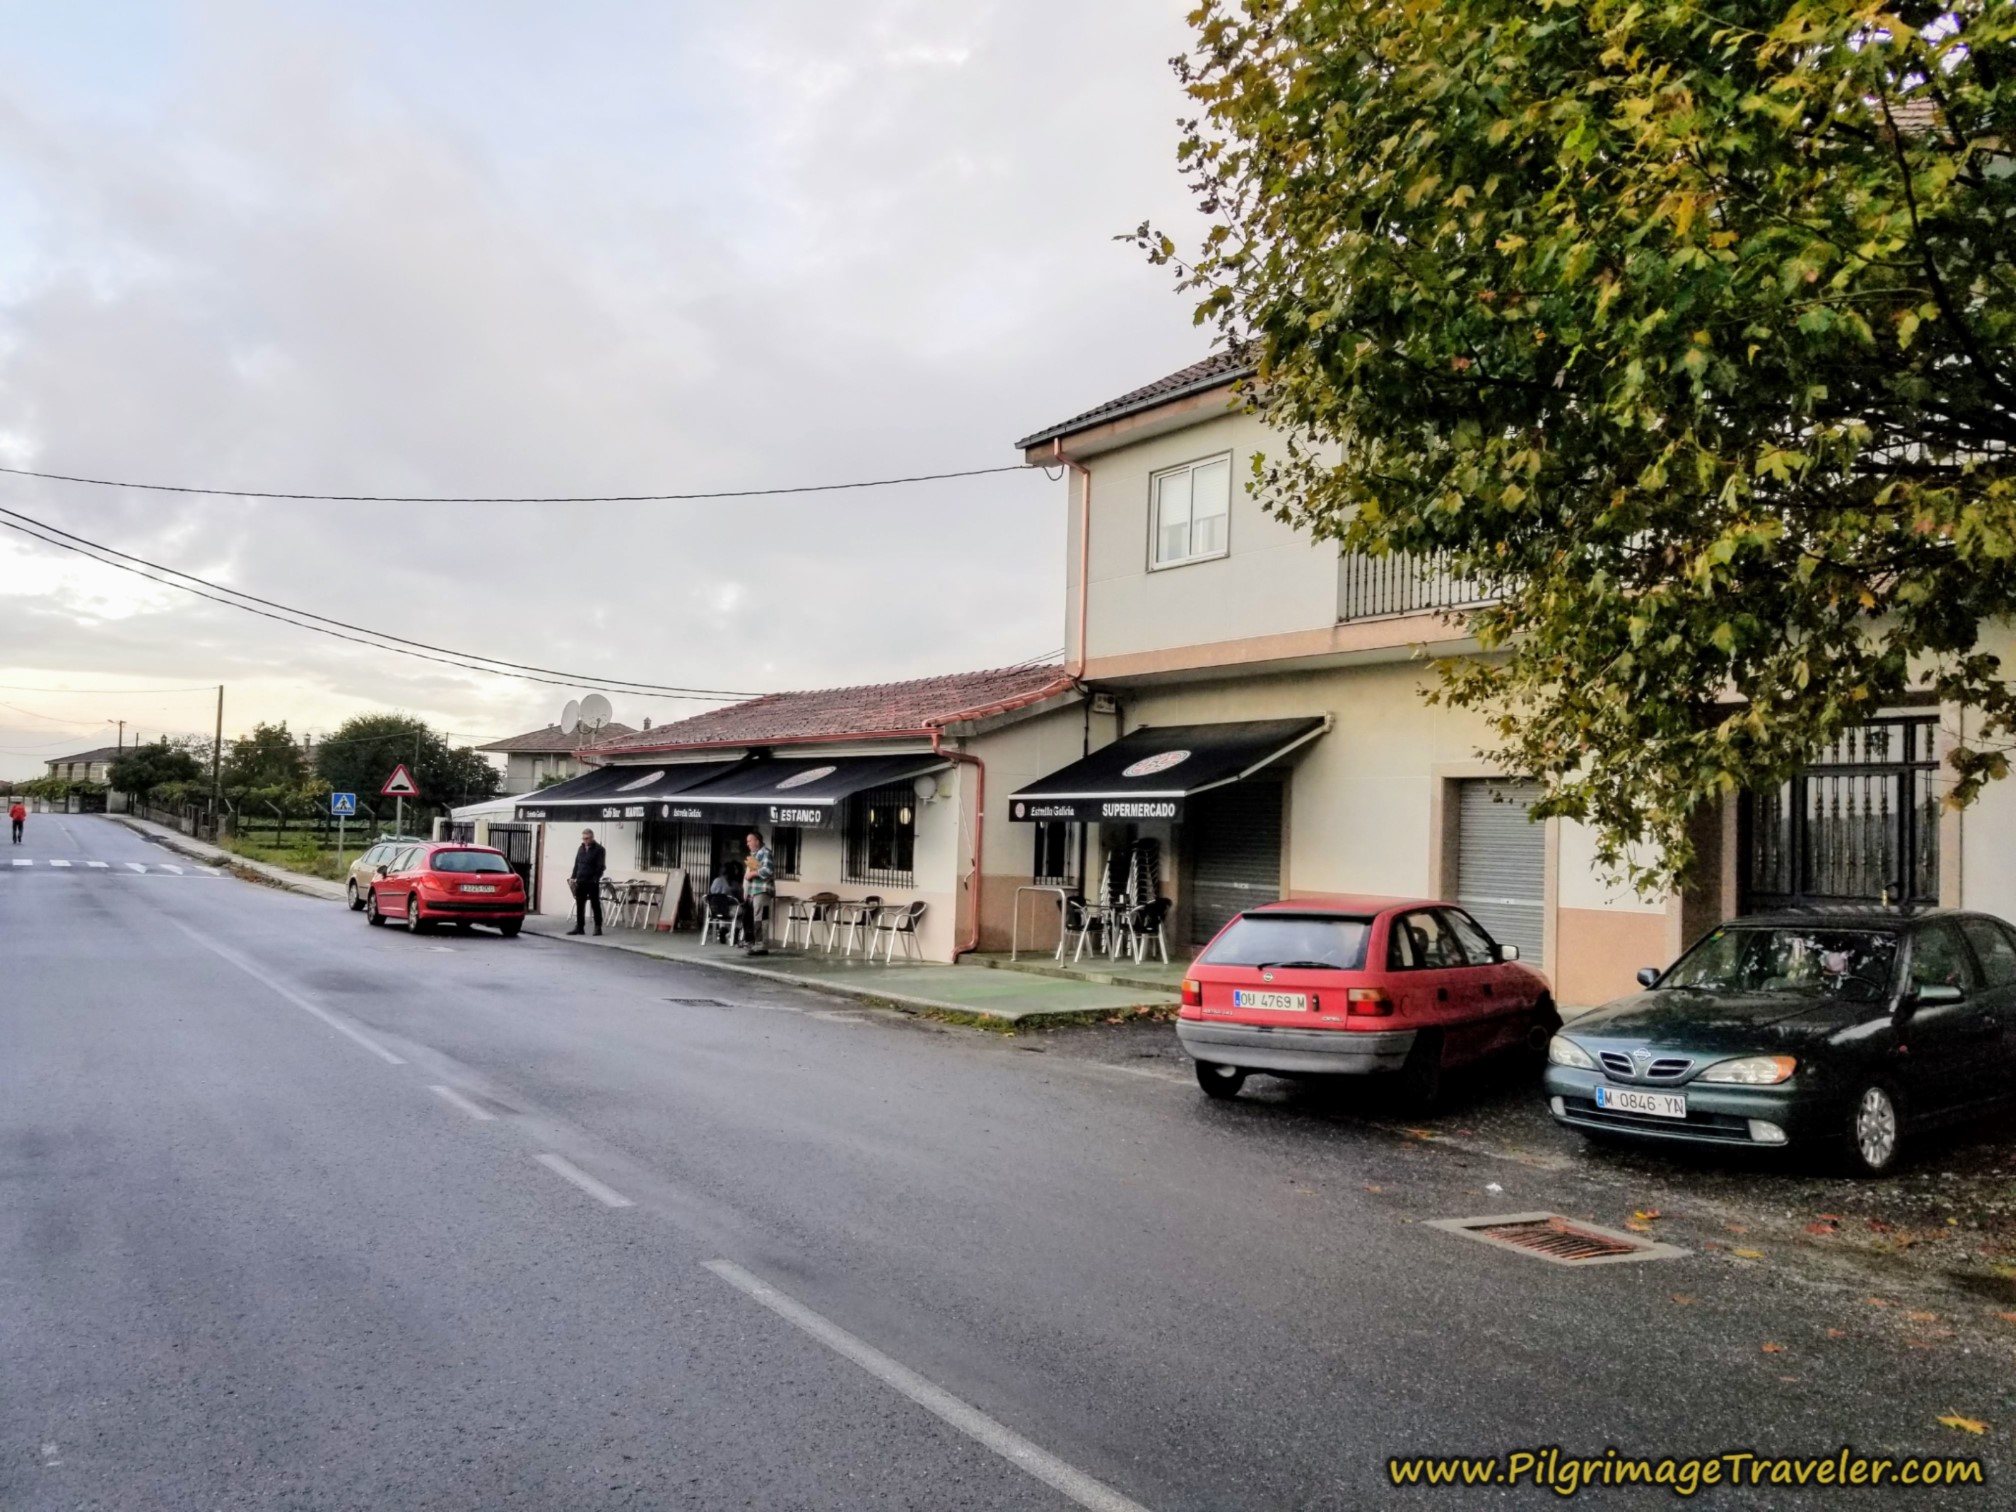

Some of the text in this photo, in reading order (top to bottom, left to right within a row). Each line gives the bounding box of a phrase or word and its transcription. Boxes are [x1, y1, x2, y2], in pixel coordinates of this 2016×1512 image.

[781, 809, 822, 823] ESTANCO
[1102, 802, 1175, 817] SUPERMERCADO
[1261, 994, 1292, 1009] 4769
[1605, 1092, 1684, 1115] M 0846 YN
